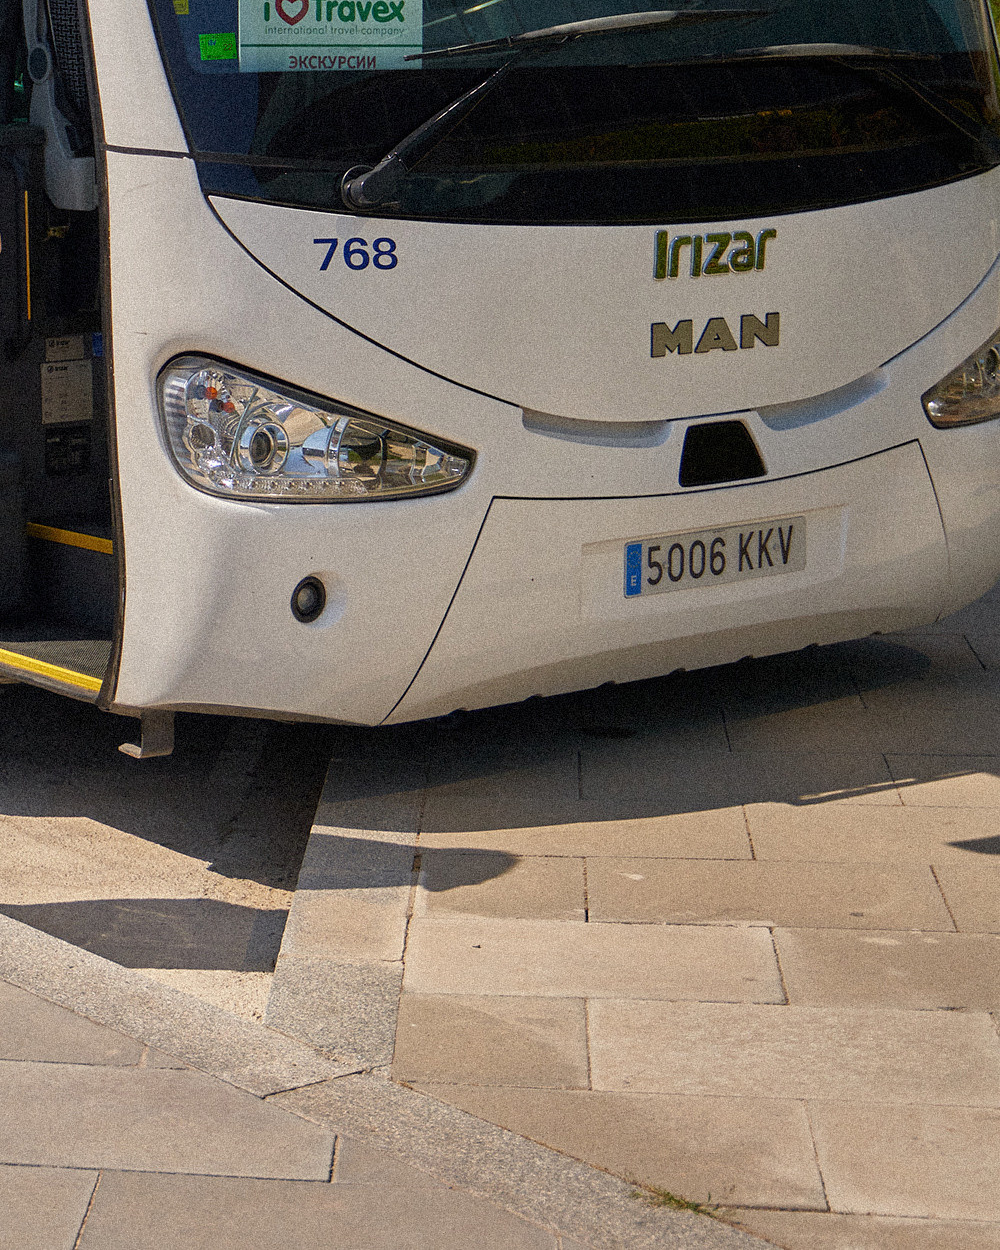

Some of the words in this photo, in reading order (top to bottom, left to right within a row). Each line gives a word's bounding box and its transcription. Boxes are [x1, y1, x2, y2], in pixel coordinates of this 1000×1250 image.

[264, 25, 328, 36] international
[331, 25, 358, 36] travel
[362, 27, 405, 38] company
[288, 55, 377, 70] ЭКСКУРСИИ
[313, 237, 399, 271] 768
[652, 228, 778, 281] Irizar
[650, 312, 781, 358] MAN
[646, 537, 727, 586] 5006
[738, 525, 794, 572] KKV
[630, 575, 638, 587] E
